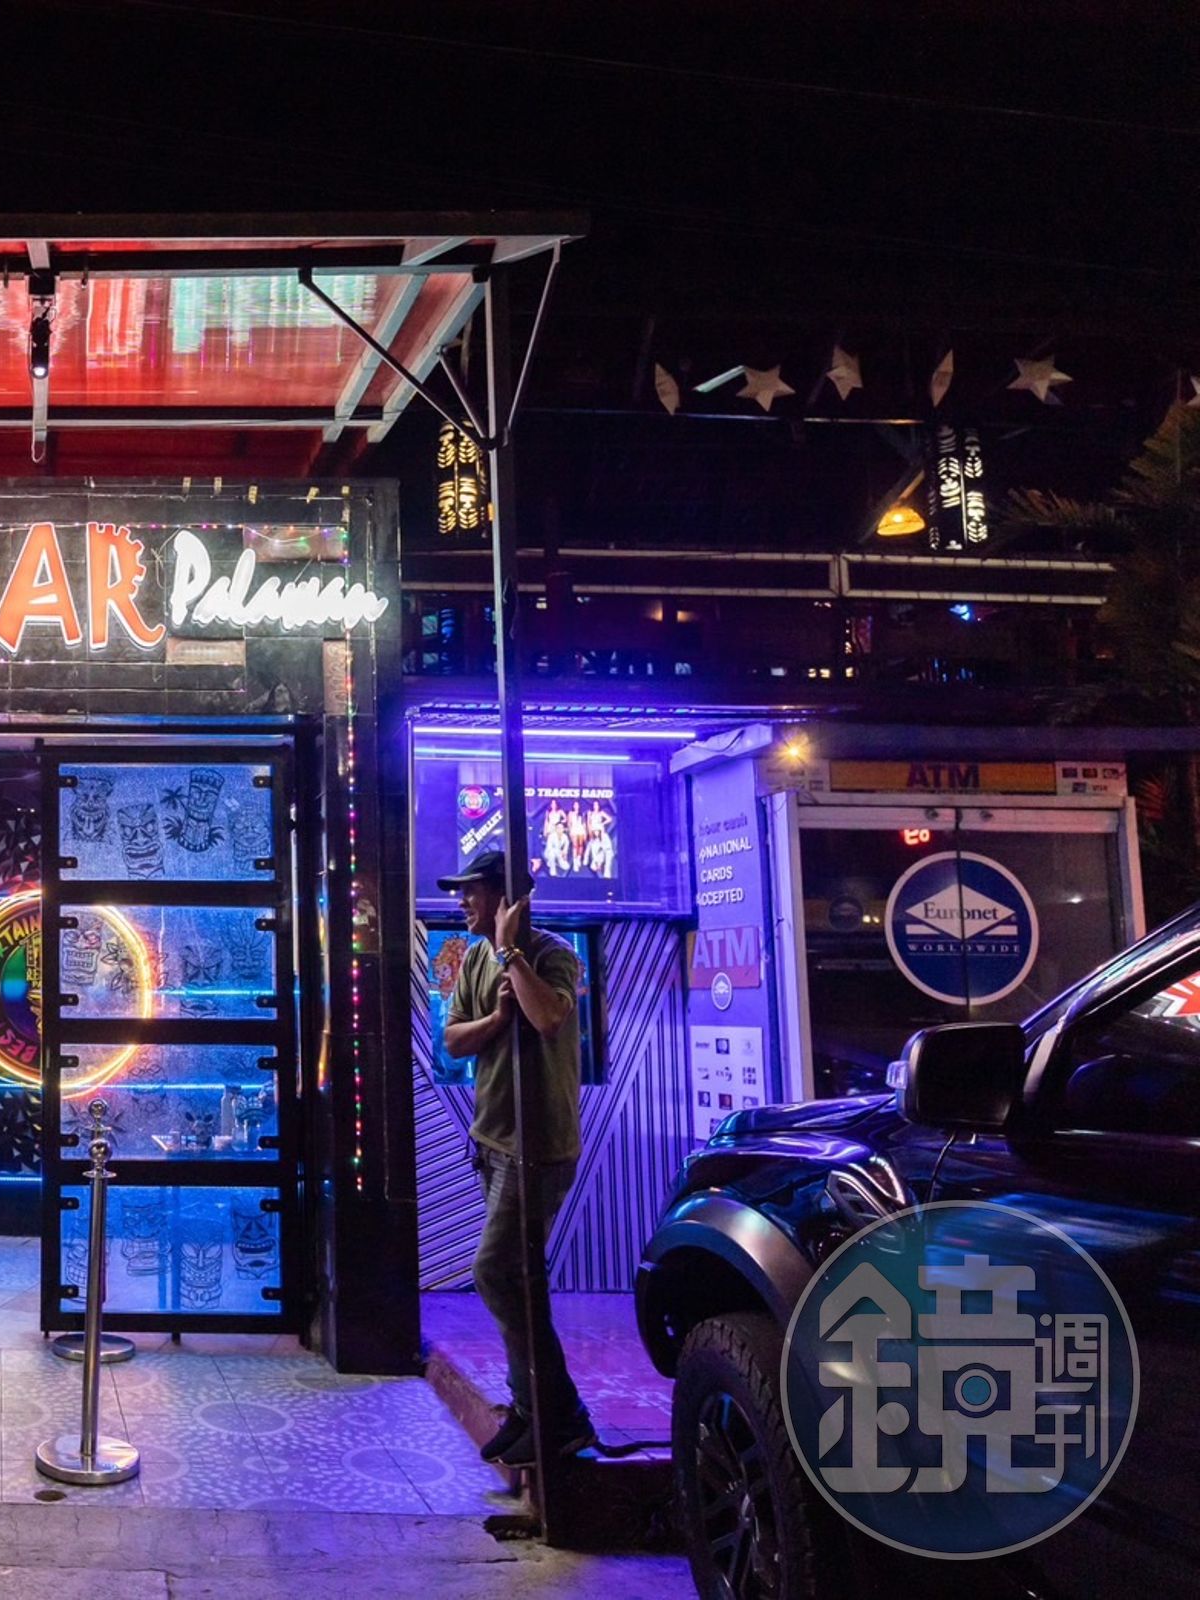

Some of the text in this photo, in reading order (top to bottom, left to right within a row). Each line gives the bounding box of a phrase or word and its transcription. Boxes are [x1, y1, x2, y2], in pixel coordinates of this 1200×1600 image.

[907, 761, 980, 788] ATM
[537, 787, 580, 798] TRACKS
[581, 788, 614, 799] BAND
[700, 865, 734, 884] CARDS
[923, 902, 998, 920] Euronet
[692, 927, 756, 969] ATM
[907, 943, 1019, 953] WORLDWIDE
